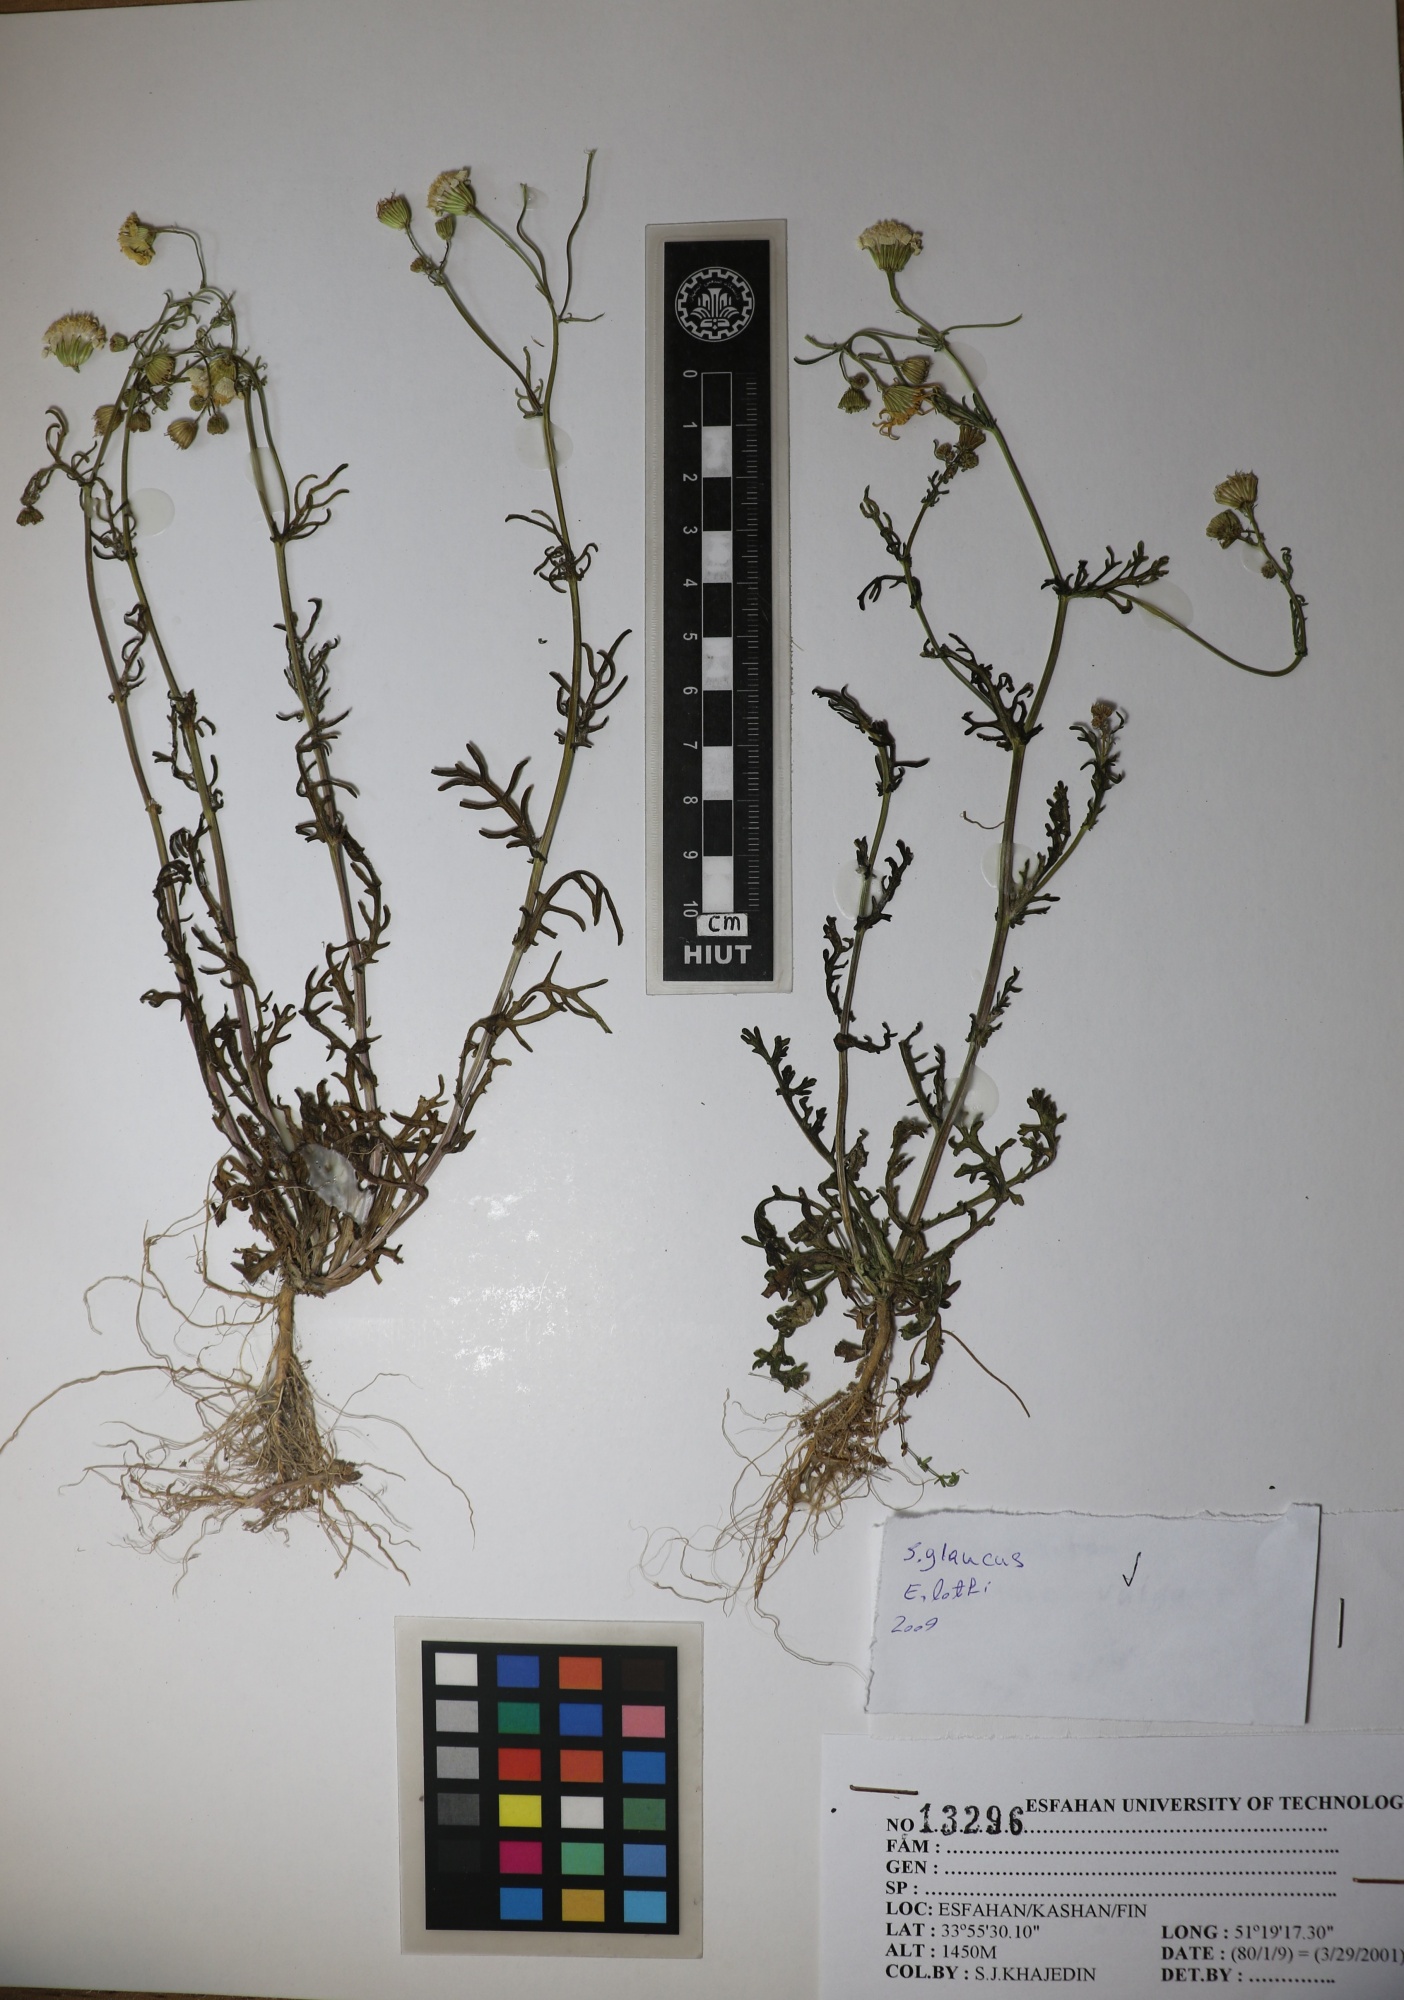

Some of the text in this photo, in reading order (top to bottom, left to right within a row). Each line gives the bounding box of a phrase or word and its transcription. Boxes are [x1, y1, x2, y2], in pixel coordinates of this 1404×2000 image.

[683, 370, 698, 378] 0
[683, 474, 698, 482] 2
[683, 526, 698, 535] 3
[683, 579, 698, 588] 4
[683, 633, 698, 641] 5
[683, 686, 698, 695] 6
[683, 741, 698, 749] 7
[683, 796, 698, 805] 8
[683, 851, 698, 860] 9
[683, 901, 699, 918] 10
[707, 914, 742, 933] cm
[684, 944, 752, 965] HIUT
[890, 1615, 939, 1633] 2009
[1025, 1797, 1116, 1813] ESFAHAN
[1122, 1796, 1242, 1812] UNIVERSITY
[1247, 1795, 1274, 1811] OF
[886, 1802, 1024, 1836] NO 13296
[885, 1859, 928, 1874] GEN
[886, 1880, 908, 1895] SP
[886, 1900, 1147, 1918] LOC: ESFAHAN/KASHAN/FIN
[886, 1922, 925, 1937] LAT
[1162, 1924, 1218, 1940] LONG
[885, 1943, 925, 1958] ALT
[942, 1945, 997, 1959] 1450M
[1162, 1946, 1214, 1961] DATE
[1231, 1946, 1294, 1963] (80/1/9)
[885, 1964, 958, 1980] COL.BY
[974, 1966, 1096, 1982] S.J.KHAJEDIN
[1161, 1967, 1233, 1983] DET.BY
